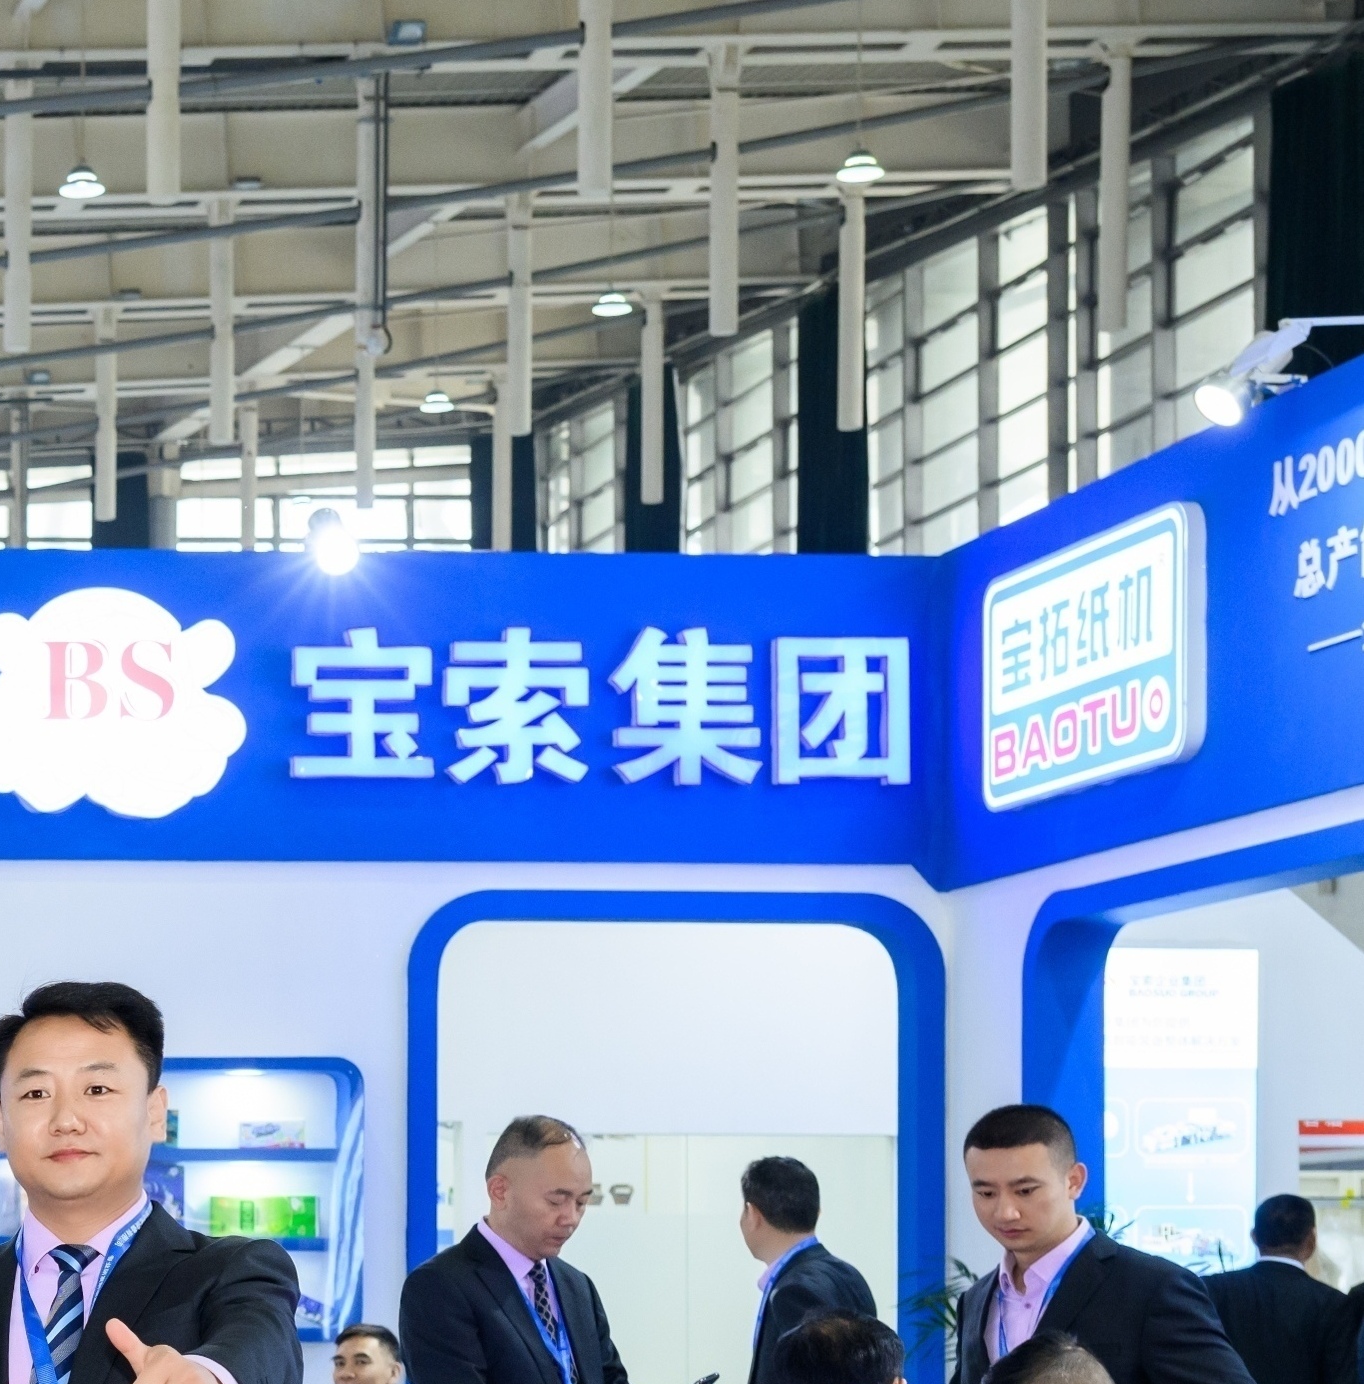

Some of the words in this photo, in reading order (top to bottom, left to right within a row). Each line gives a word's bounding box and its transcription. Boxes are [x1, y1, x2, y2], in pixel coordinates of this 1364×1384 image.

[1293, 524, 1364, 599] 总产
[1000, 563, 1155, 697] 宝拓纸机
[44, 638, 177, 723] BS
[288, 625, 912, 786] 宝索集团
[992, 686, 1165, 781] BAOTUO
